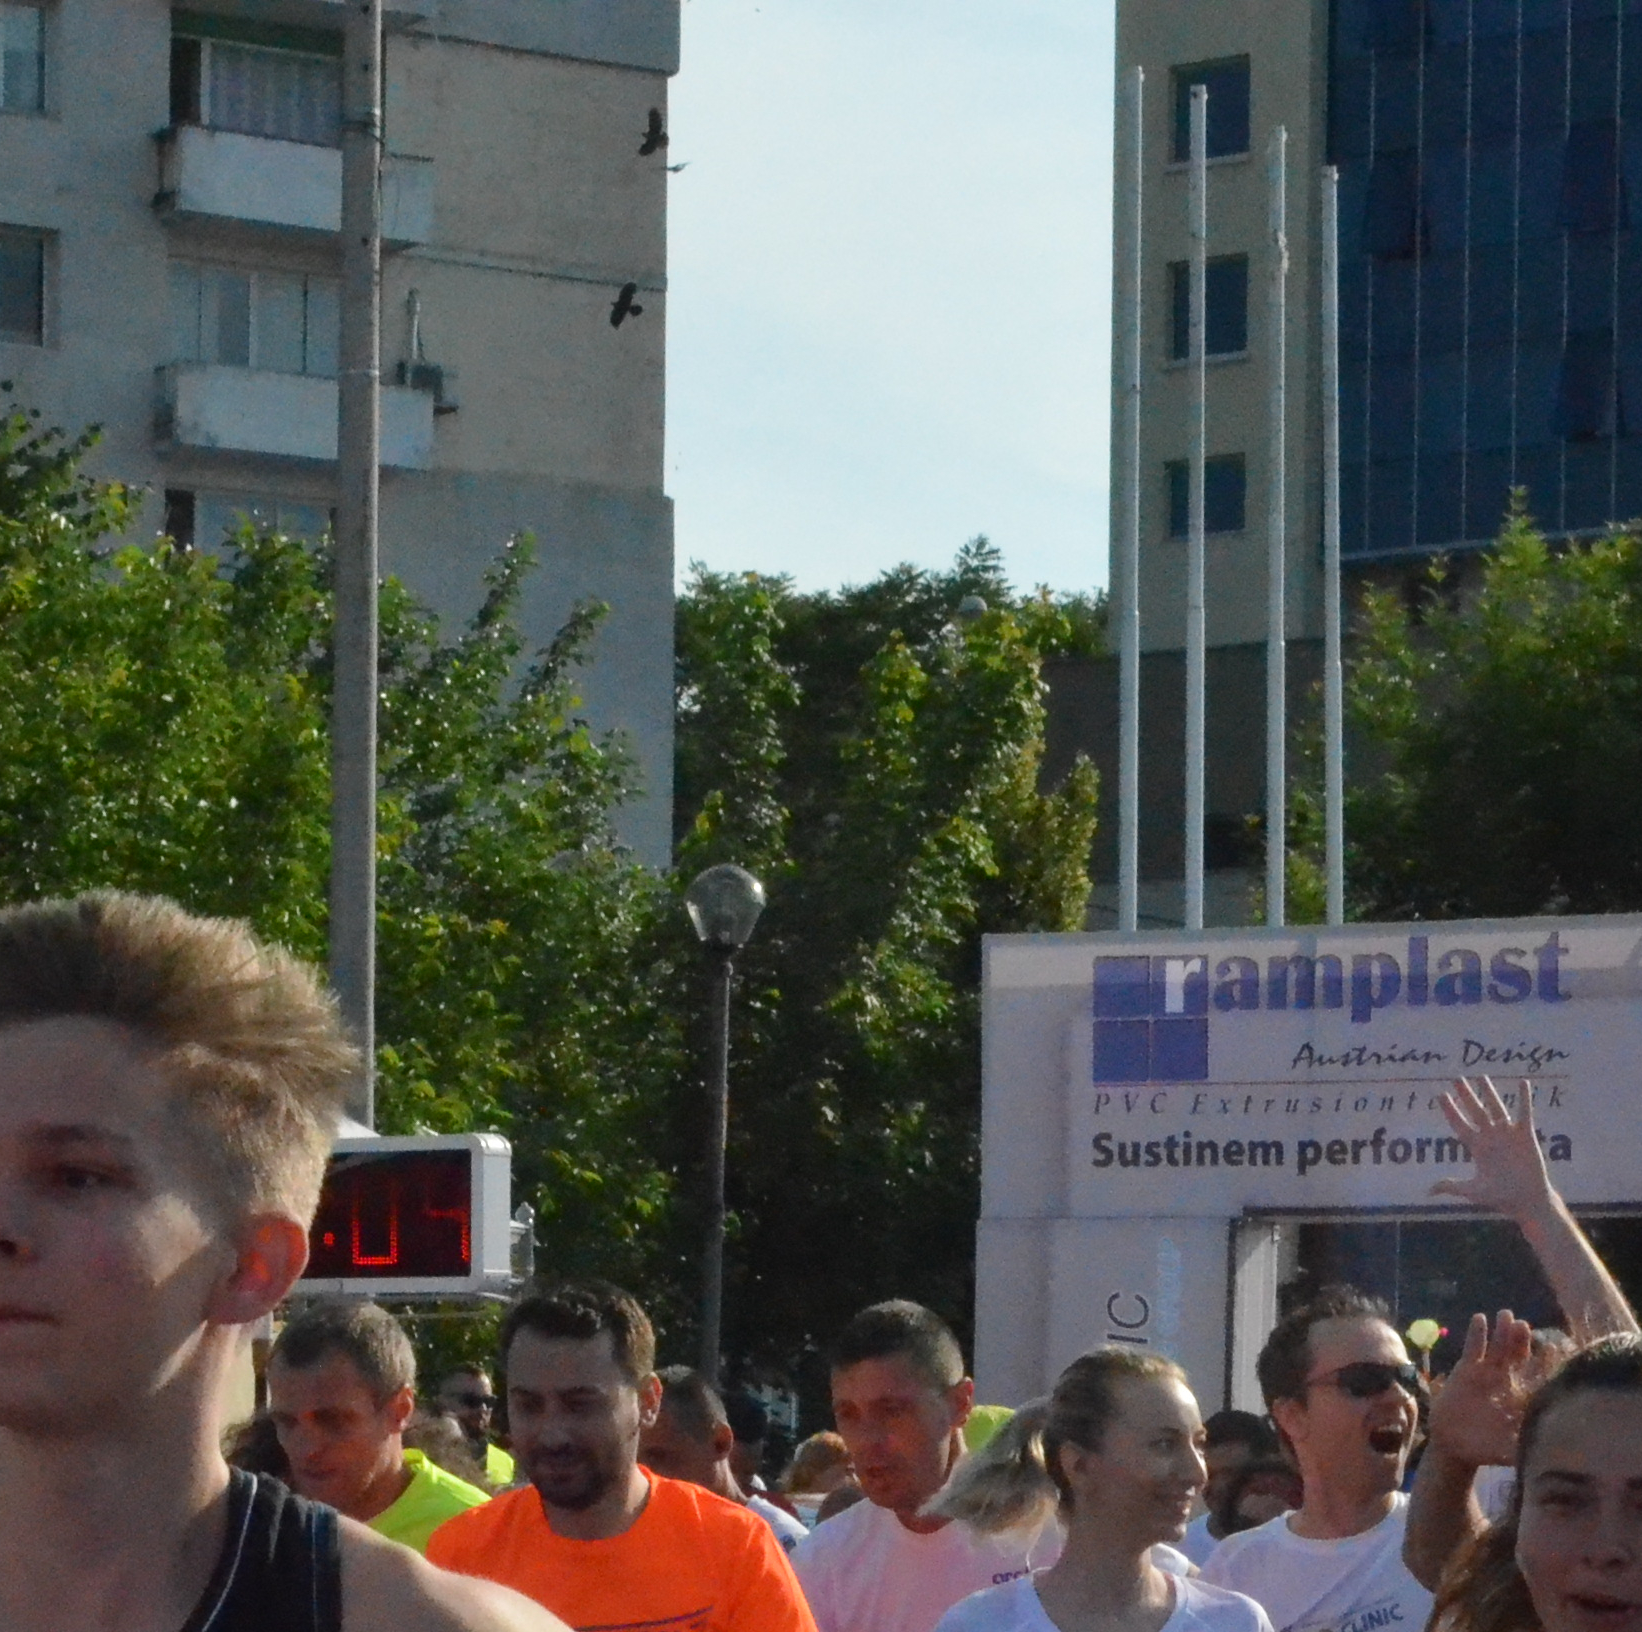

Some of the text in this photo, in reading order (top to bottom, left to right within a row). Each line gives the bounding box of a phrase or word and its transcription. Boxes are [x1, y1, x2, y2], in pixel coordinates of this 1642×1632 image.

[1163, 931, 1573, 1023] ramplast
[1291, 1038, 1570, 1070] Austrian Design
[1093, 1084, 1564, 1115] PVC Extrusiontenik
[1091, 1127, 1573, 1176] Sustinem performta
